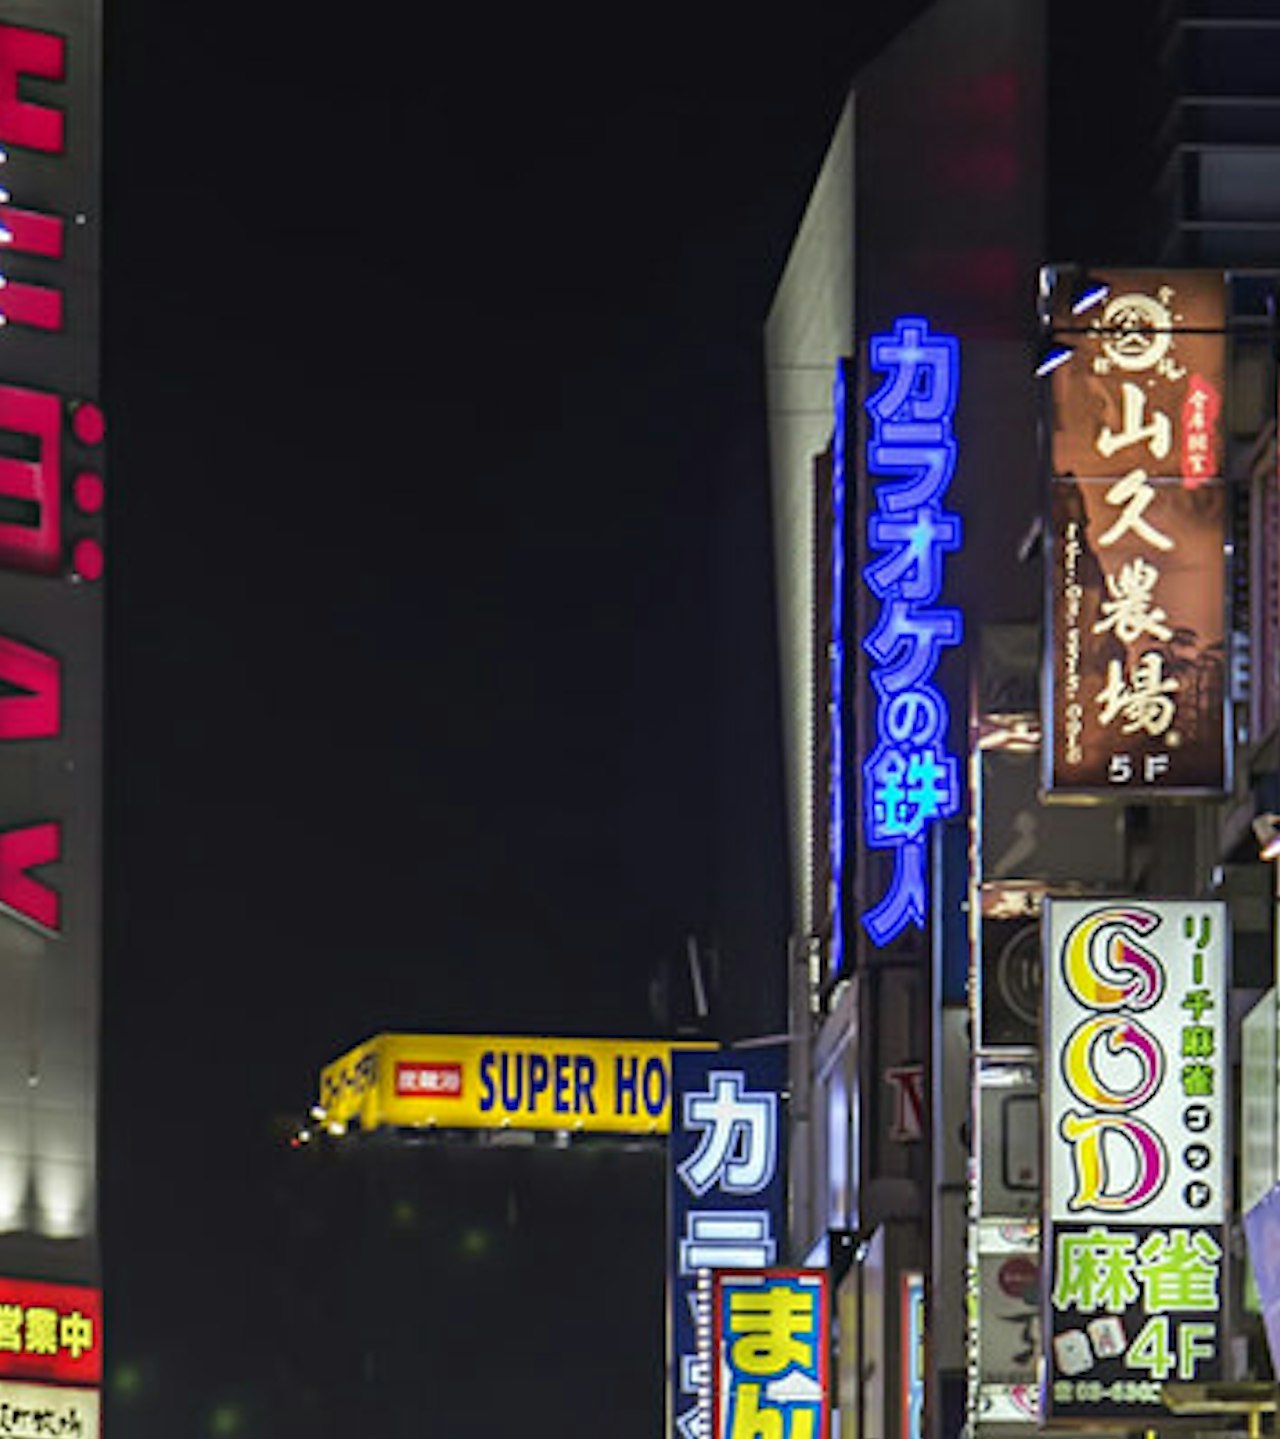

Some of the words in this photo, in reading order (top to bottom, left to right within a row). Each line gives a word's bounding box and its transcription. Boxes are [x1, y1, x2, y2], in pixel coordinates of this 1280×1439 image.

[860, 316, 962, 946] カラオケの鉄人
[1109, 755, 1170, 783] 5F
[1181, 916, 1216, 1096] リーチ麻雀
[480, 1051, 596, 1115] SUPER
[1060, 905, 1166, 1212] GOD
[1052, 1226, 1220, 1312] 麻雀
[1124, 1320, 1214, 1380] 4F
